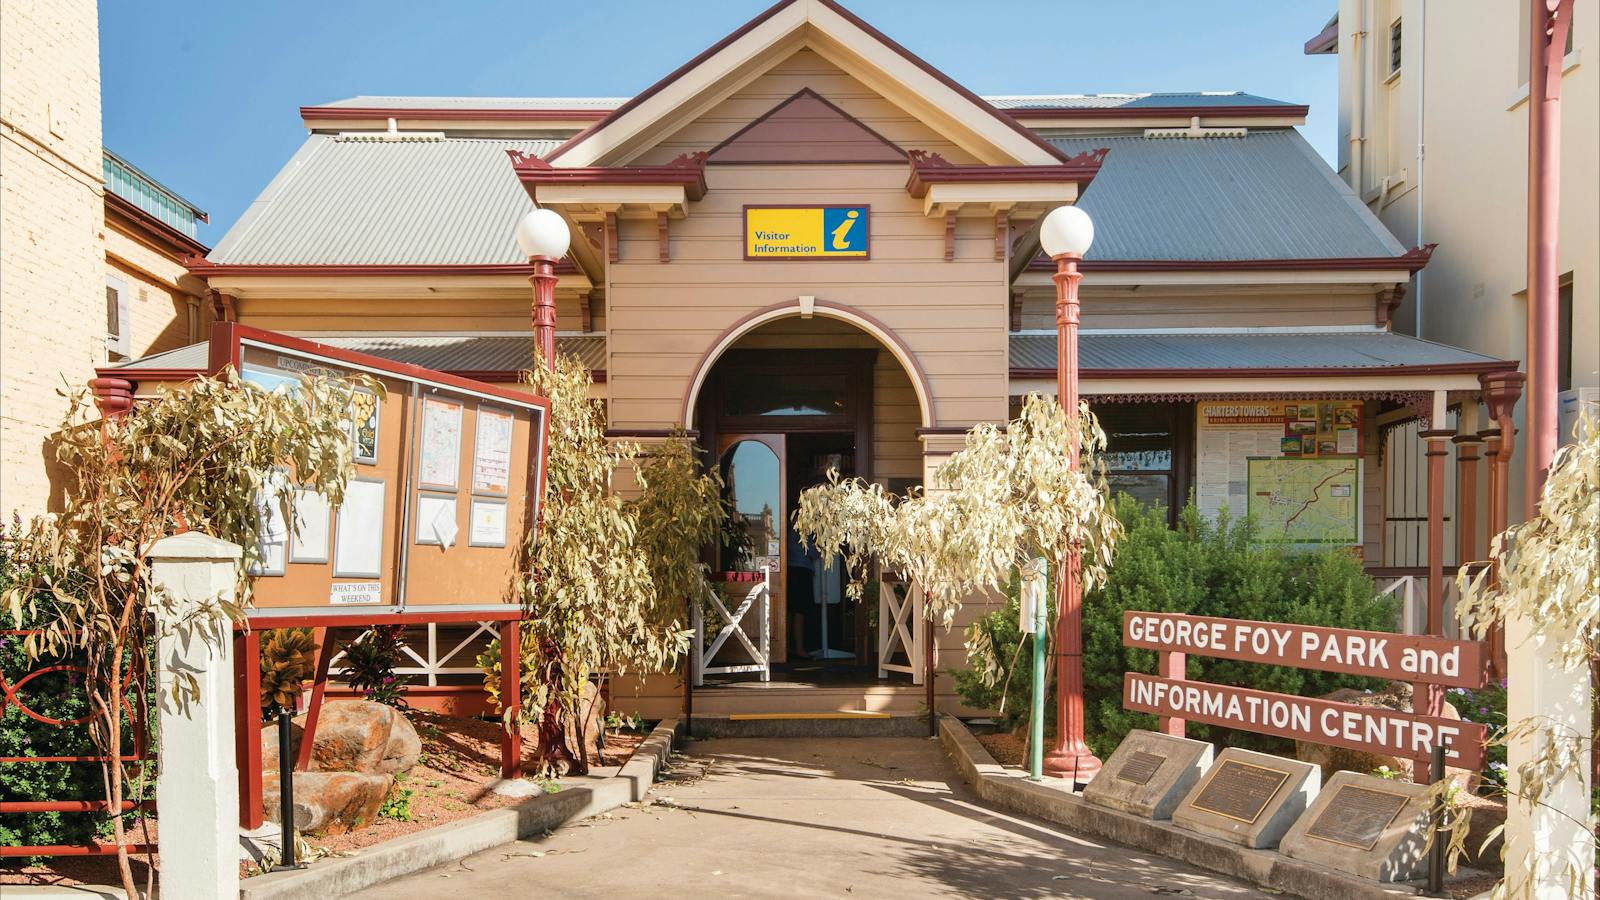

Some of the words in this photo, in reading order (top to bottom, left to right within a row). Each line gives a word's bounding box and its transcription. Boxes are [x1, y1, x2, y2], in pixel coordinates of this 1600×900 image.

[755, 231, 790, 240] Visitor
[754, 244, 816, 253] Information
[1202, 406, 1239, 417] CHARTERS
[1240, 406, 1270, 417] TOWERS
[332, 584, 356, 592] WHAT'S
[357, 584, 366, 592] ON
[367, 583, 380, 591] THIS
[341, 594, 371, 602] WEEKEND
[1128, 616, 1227, 651] GEORGE
[1234, 625, 1292, 657] FOY
[1301, 632, 1389, 670] PARK
[1400, 645, 1459, 677] and
[1130, 678, 1312, 733] INFORMATION
[1320, 708, 1460, 759] CENTRE
